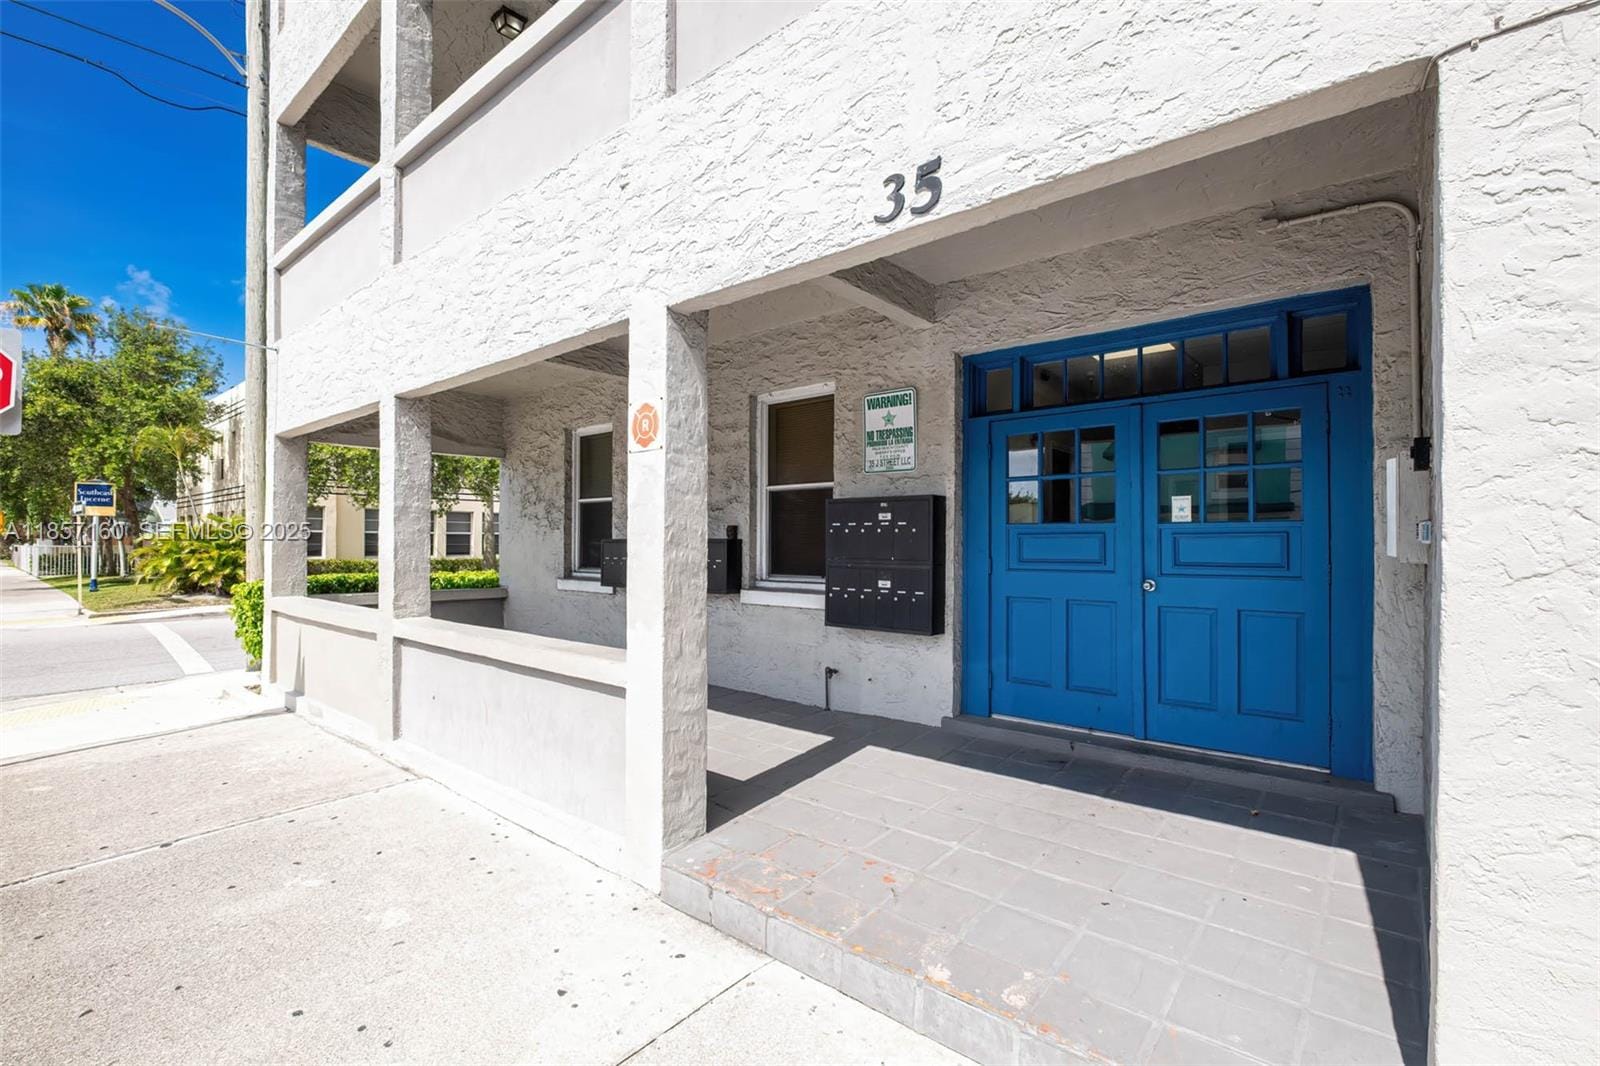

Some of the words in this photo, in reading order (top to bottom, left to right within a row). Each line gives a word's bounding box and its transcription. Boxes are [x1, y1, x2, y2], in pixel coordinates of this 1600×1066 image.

[874, 155, 942, 223] 35
[867, 392, 912, 410] WARNING!
[867, 430, 875, 442] NO
[876, 426, 913, 440] TRESPASSING
[880, 457, 900, 467] STREET
[901, 456, 911, 466] LLC
